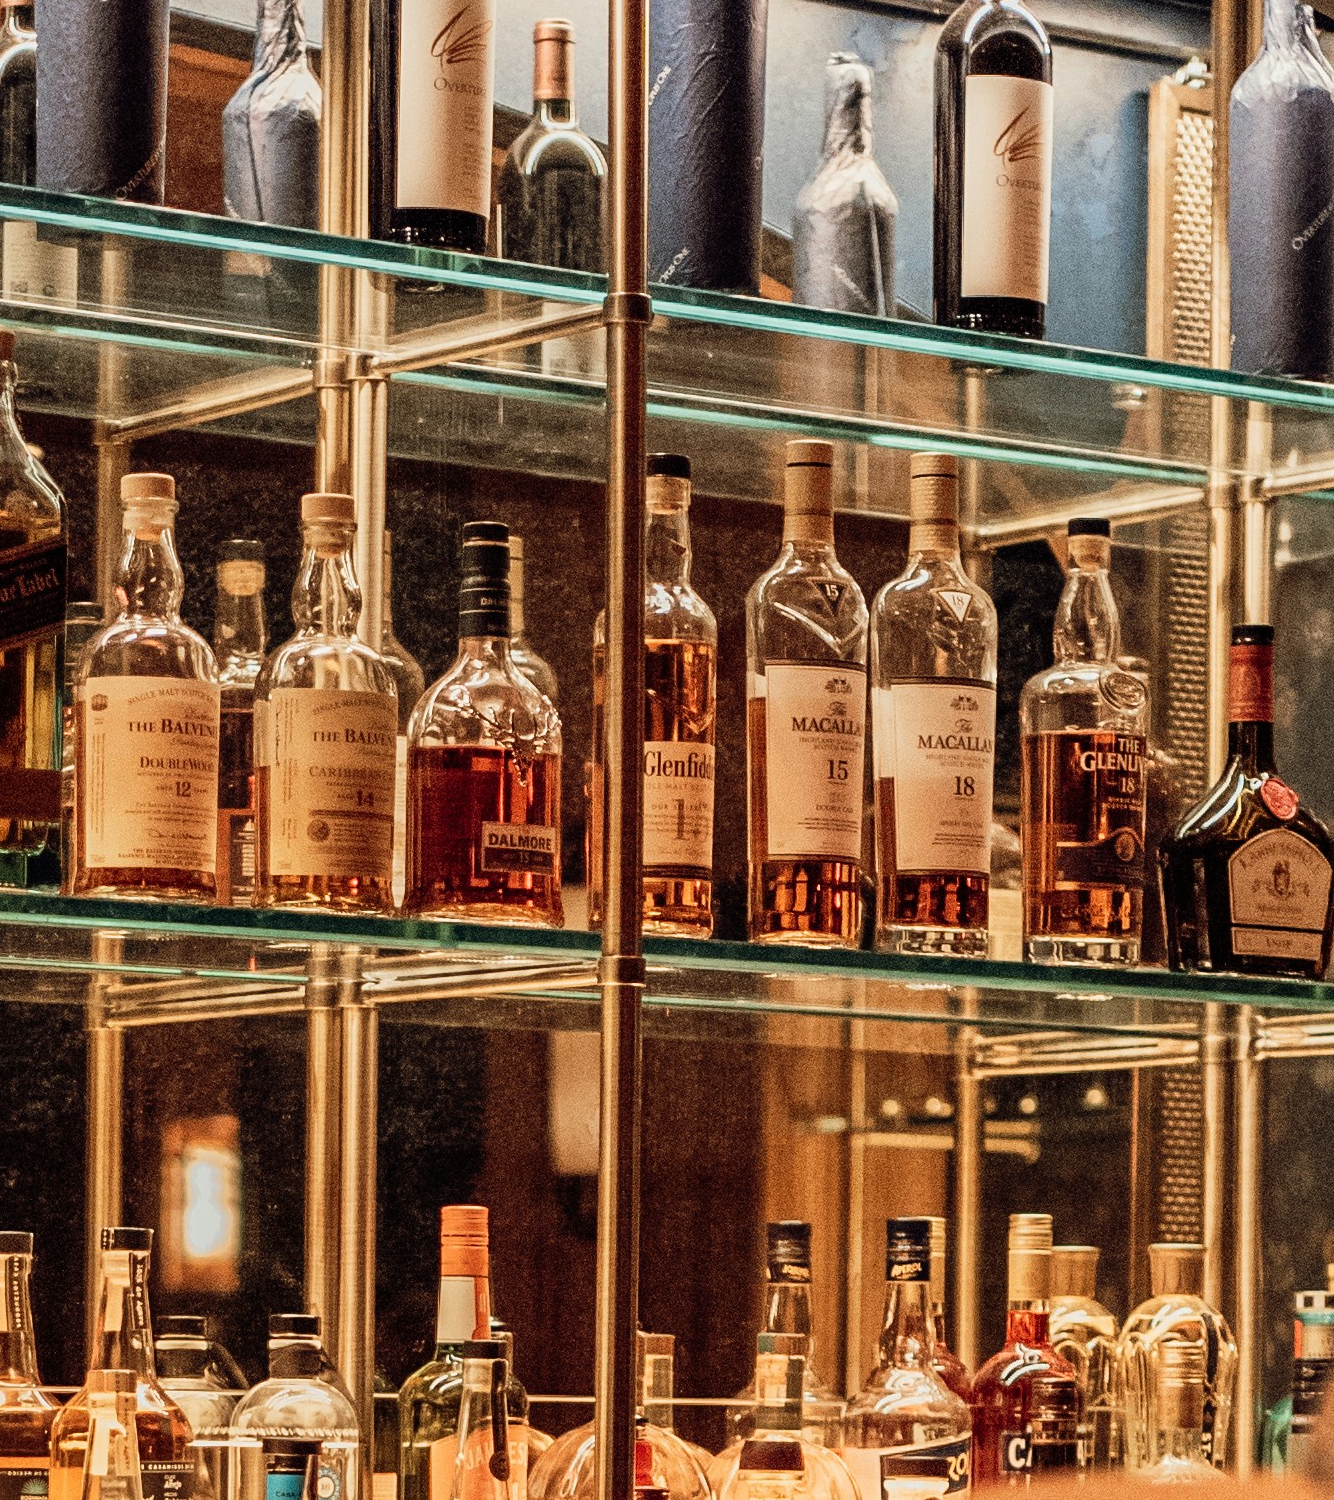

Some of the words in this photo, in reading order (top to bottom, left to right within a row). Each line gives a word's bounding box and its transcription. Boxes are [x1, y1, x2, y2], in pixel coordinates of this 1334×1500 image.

[825, 583, 839, 598] 15
[950, 595, 964, 608] 18
[128, 721, 157, 733] THE
[313, 730, 340, 742] THE
[1117, 738, 1140, 753] THE
[827, 759, 848, 781] 15
[175, 780, 192, 798] 12
[954, 775, 975, 797] 18
[1121, 777, 1136, 795] 18
[488, 832, 552, 851] DALMORE
